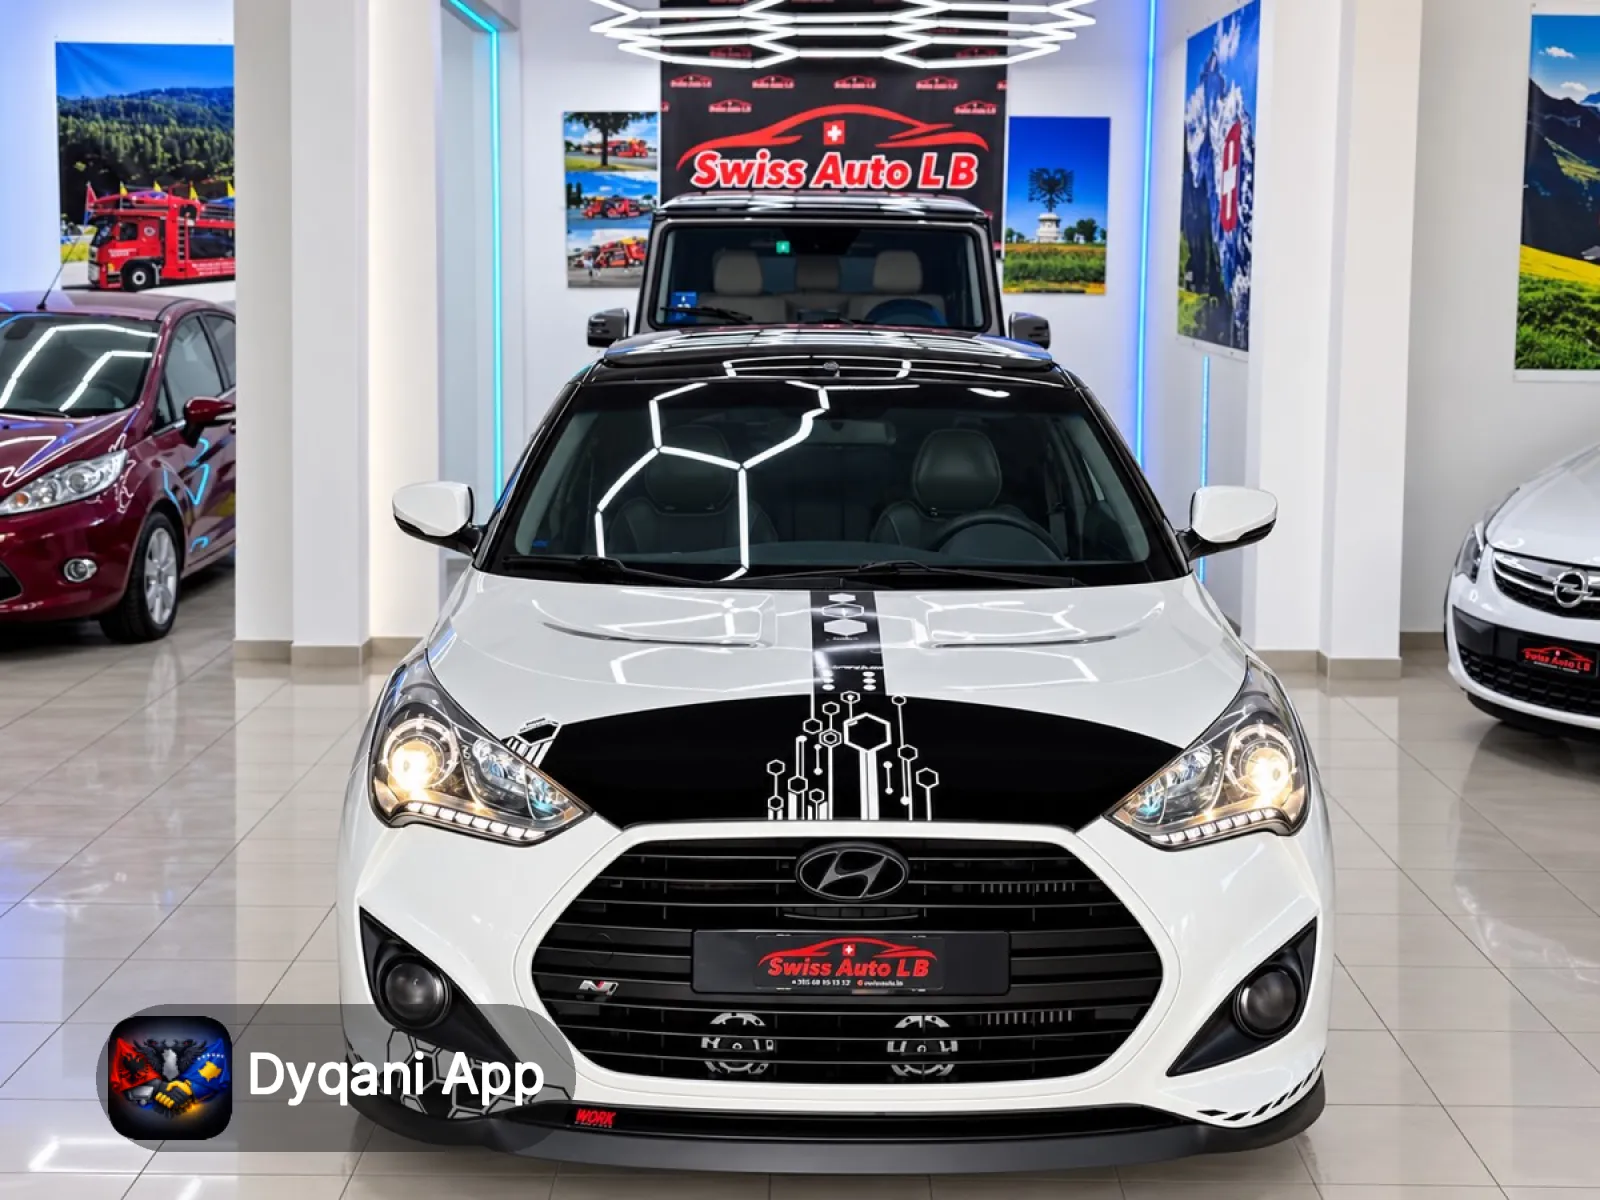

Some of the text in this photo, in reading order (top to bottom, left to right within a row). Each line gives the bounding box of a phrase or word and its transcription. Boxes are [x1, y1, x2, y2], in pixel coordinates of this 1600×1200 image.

[691, 148, 807, 188] Swiss
[809, 151, 912, 188] Auto
[768, 957, 832, 977] Swiss
[835, 958, 892, 977] Auto
[576, 1108, 616, 1125] WORK
